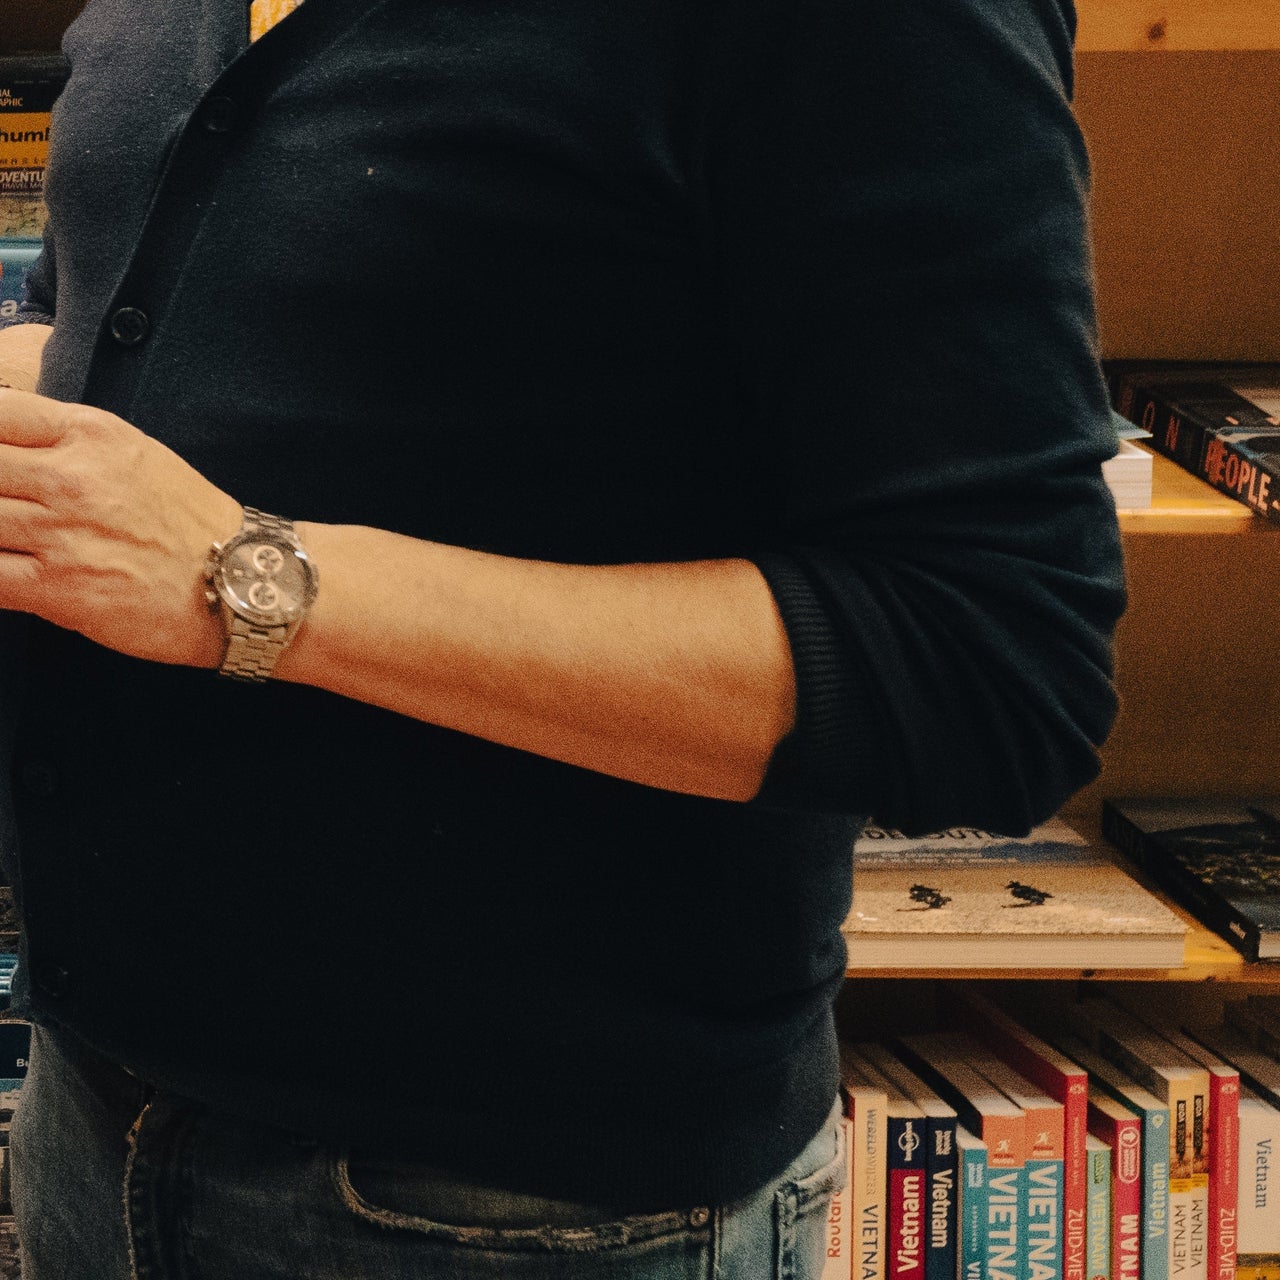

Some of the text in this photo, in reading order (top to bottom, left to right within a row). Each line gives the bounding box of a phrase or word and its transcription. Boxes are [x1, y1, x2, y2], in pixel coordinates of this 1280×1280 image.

[932, 1169, 952, 1247] Vietnam
[1148, 1163, 1167, 1238] Vietnam
[1254, 1139, 1271, 1209] Vietnam
[897, 1174, 921, 1273] Vietnam
